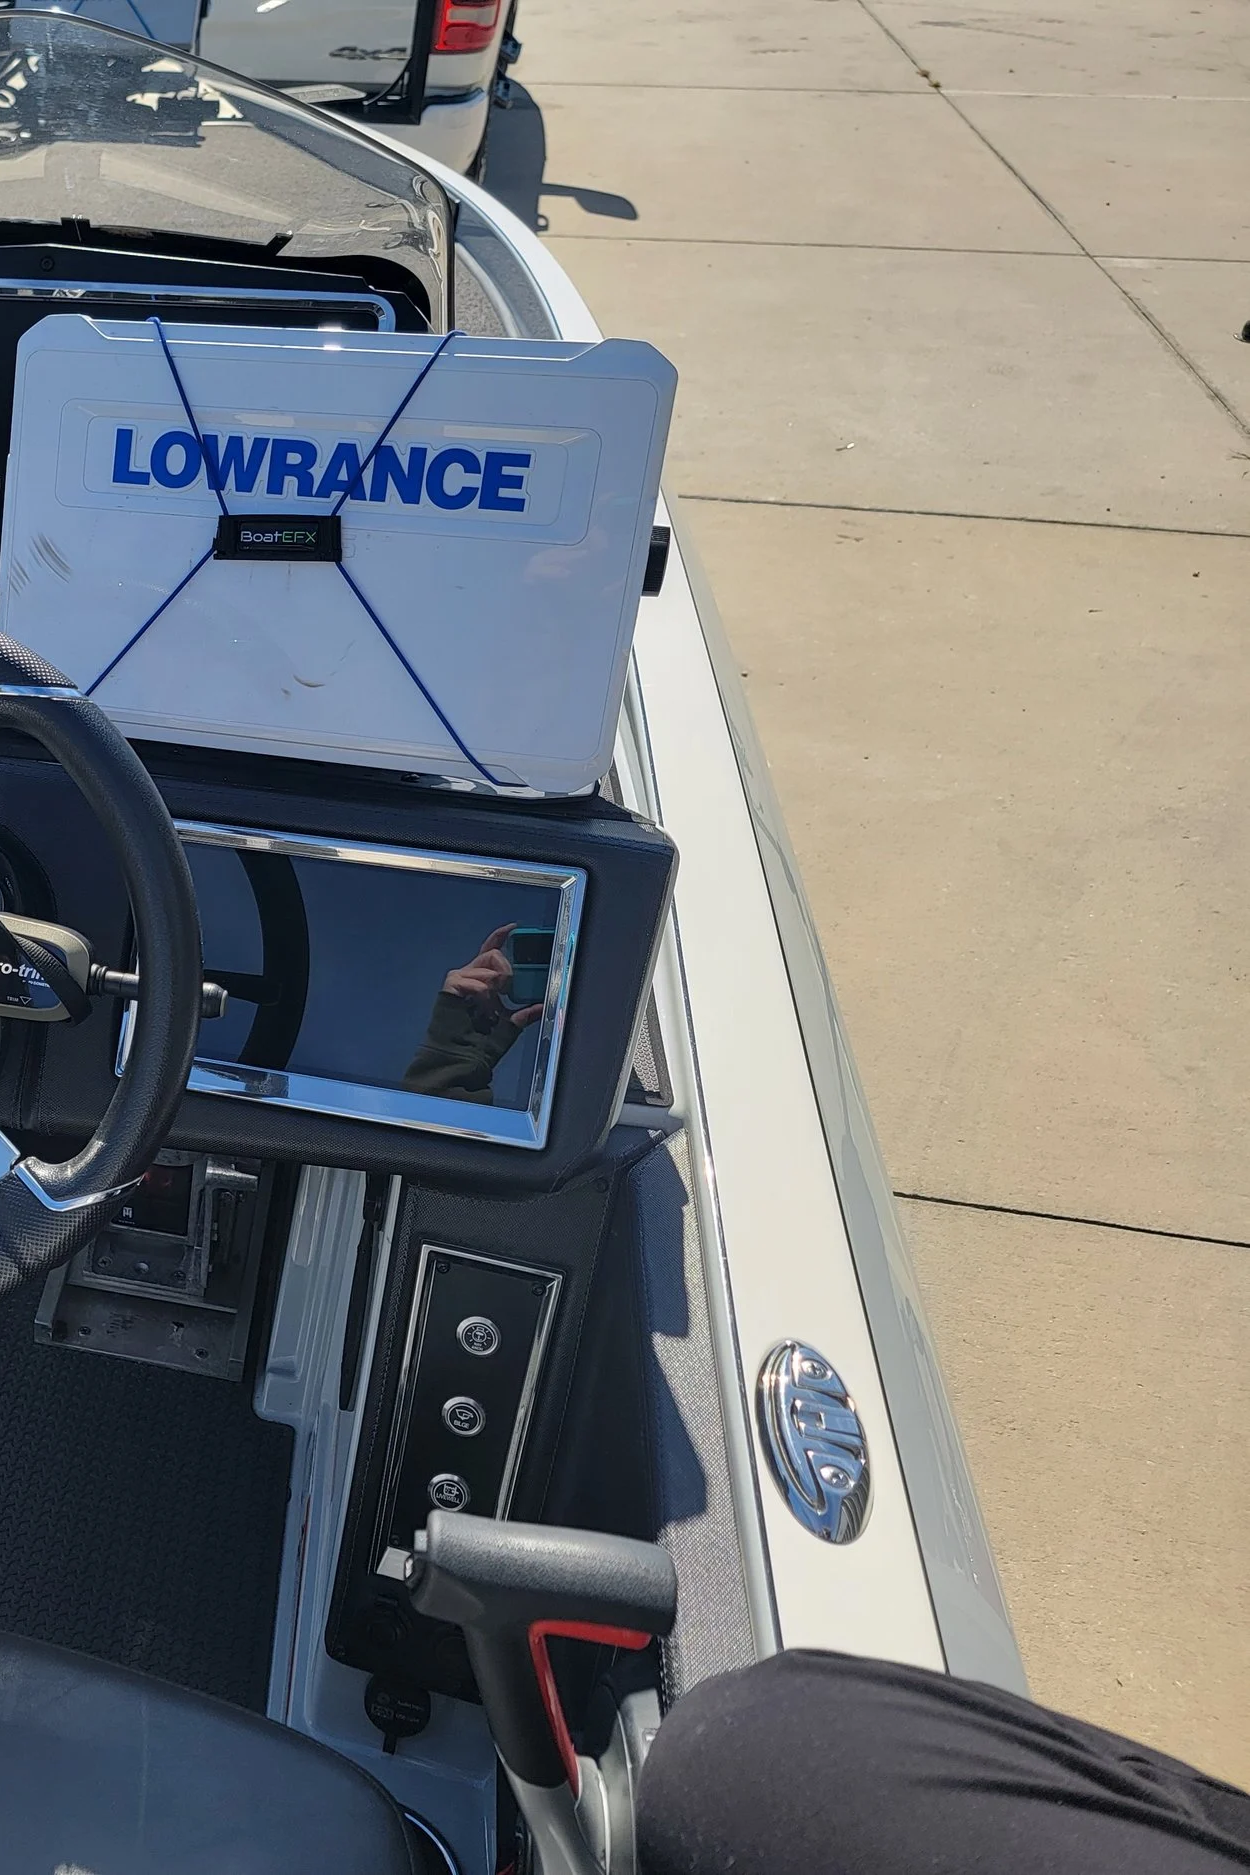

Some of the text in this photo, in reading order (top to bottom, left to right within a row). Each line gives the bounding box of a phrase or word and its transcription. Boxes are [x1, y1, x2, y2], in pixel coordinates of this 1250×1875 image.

[111, 428, 532, 512] LOWRANCE
[240, 531, 317, 543] BoatEFX
[453, 1419, 470, 1429] BILGE
[435, 1492, 461, 1504] LIVEWELL
